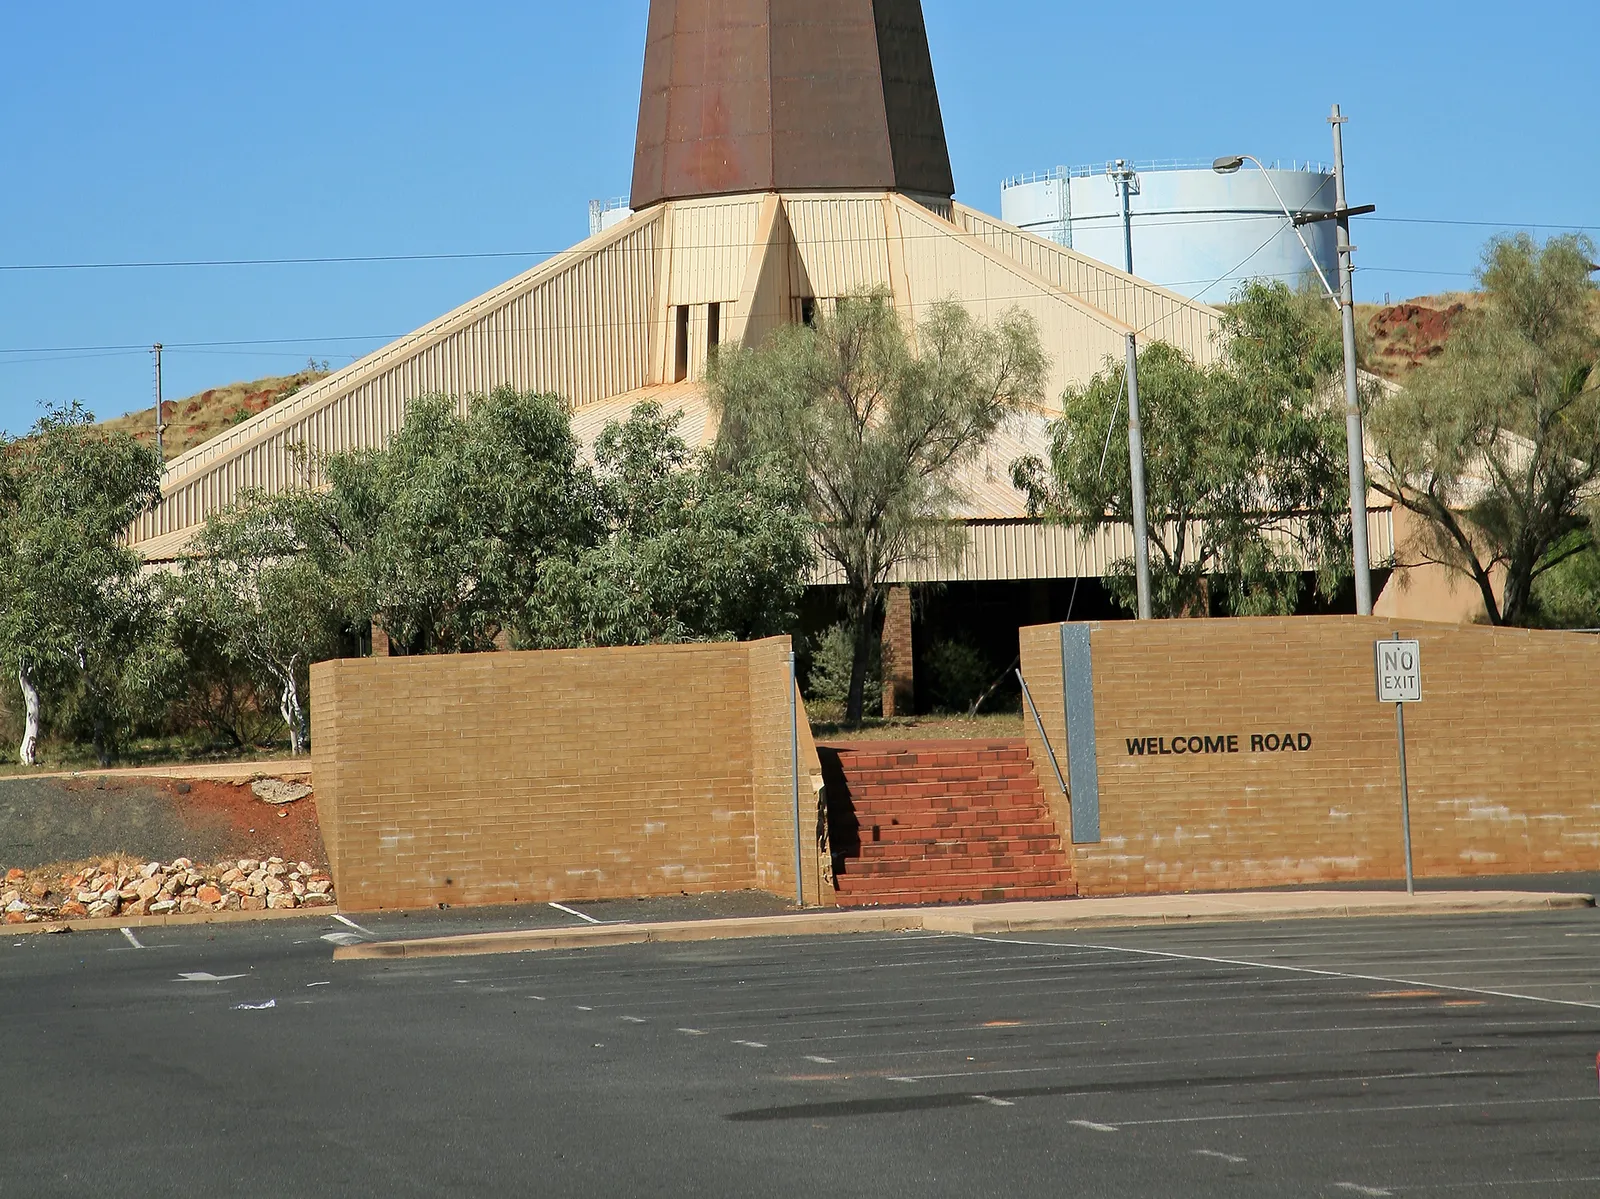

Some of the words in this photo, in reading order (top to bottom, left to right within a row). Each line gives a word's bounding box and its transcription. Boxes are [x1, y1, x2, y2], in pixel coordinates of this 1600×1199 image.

[1384, 651, 1413, 671] NO
[1384, 676, 1415, 689] EXIT
[1126, 735, 1239, 755] WELCOME
[1250, 733, 1312, 752] ROAD
